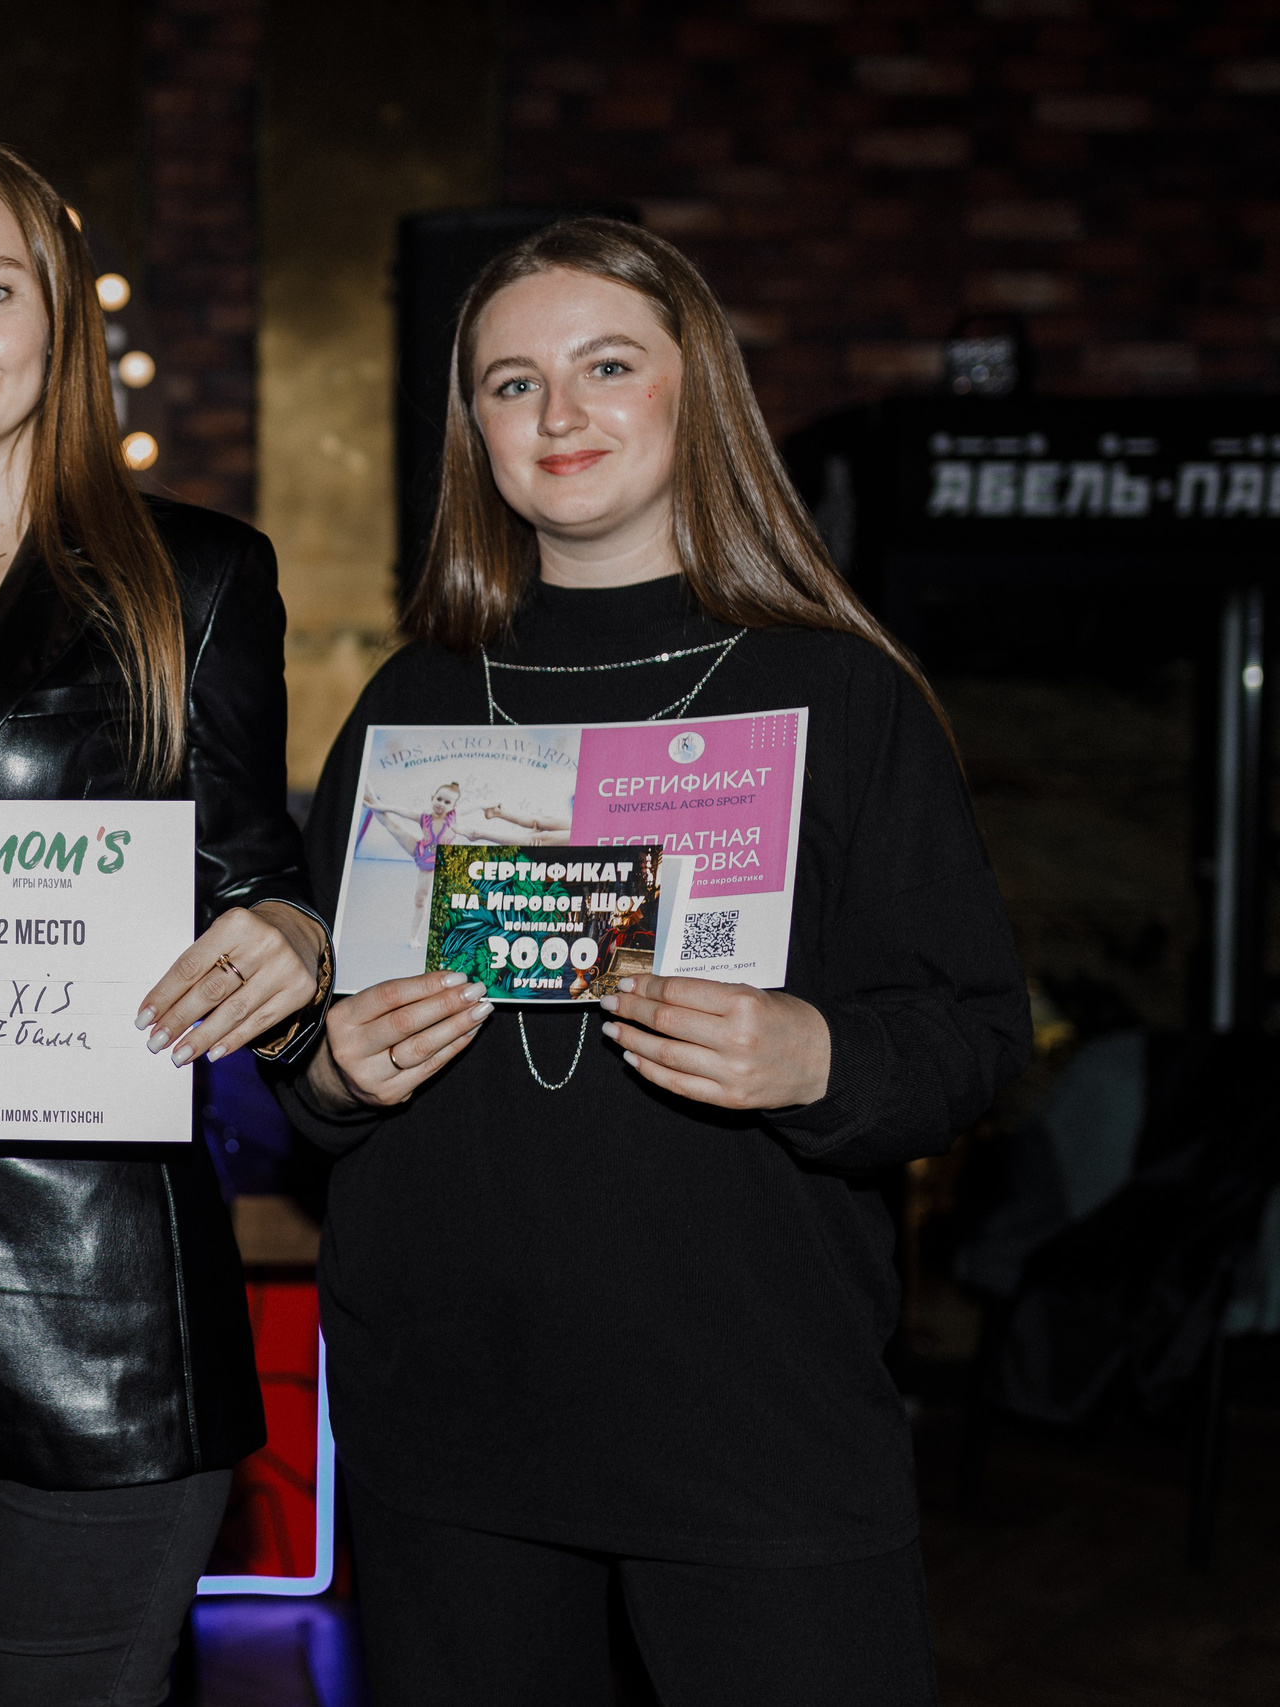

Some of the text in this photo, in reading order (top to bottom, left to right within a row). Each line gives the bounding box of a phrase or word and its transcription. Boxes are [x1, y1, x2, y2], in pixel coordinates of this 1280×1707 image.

[598, 767, 772, 797] СЕРТИФИКАТ
[608, 794, 756, 813] UNIVERSAL ACRO SPORT
[468, 860, 634, 882] СЕРТИФИКАТ
[710, 873, 764, 886] акробатике
[12, 878, 73, 889] ИГРЫ РАЗУМА
[15, 919, 86, 945] МЕСТО
[488, 935, 598, 970] 3000
